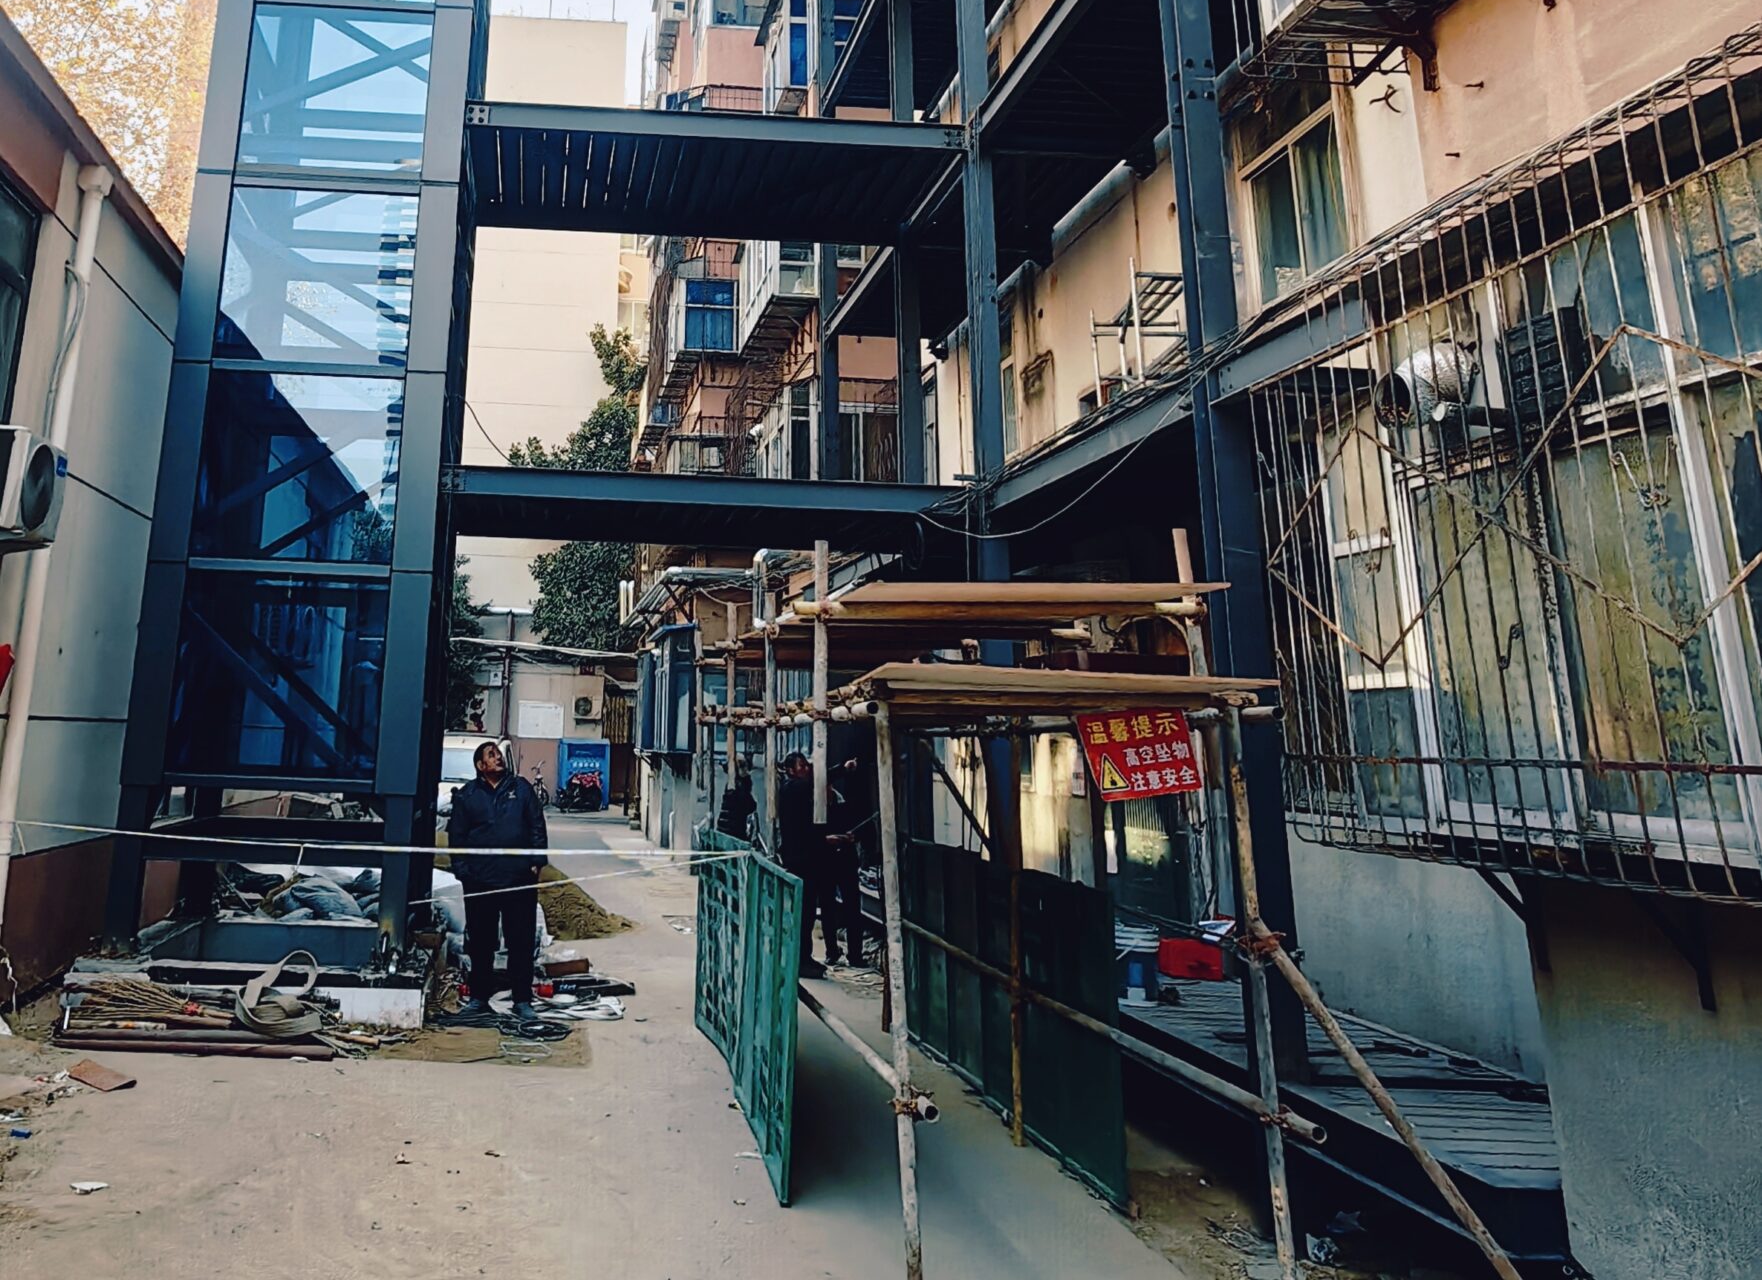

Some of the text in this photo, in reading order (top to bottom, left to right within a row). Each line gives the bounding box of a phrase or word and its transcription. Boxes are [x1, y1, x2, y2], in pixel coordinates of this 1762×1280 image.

[1086, 712, 1179, 744] 温馨提示
[1122, 741, 1190, 767] 高空坠物
[1131, 765, 1196, 791] 注意安全
